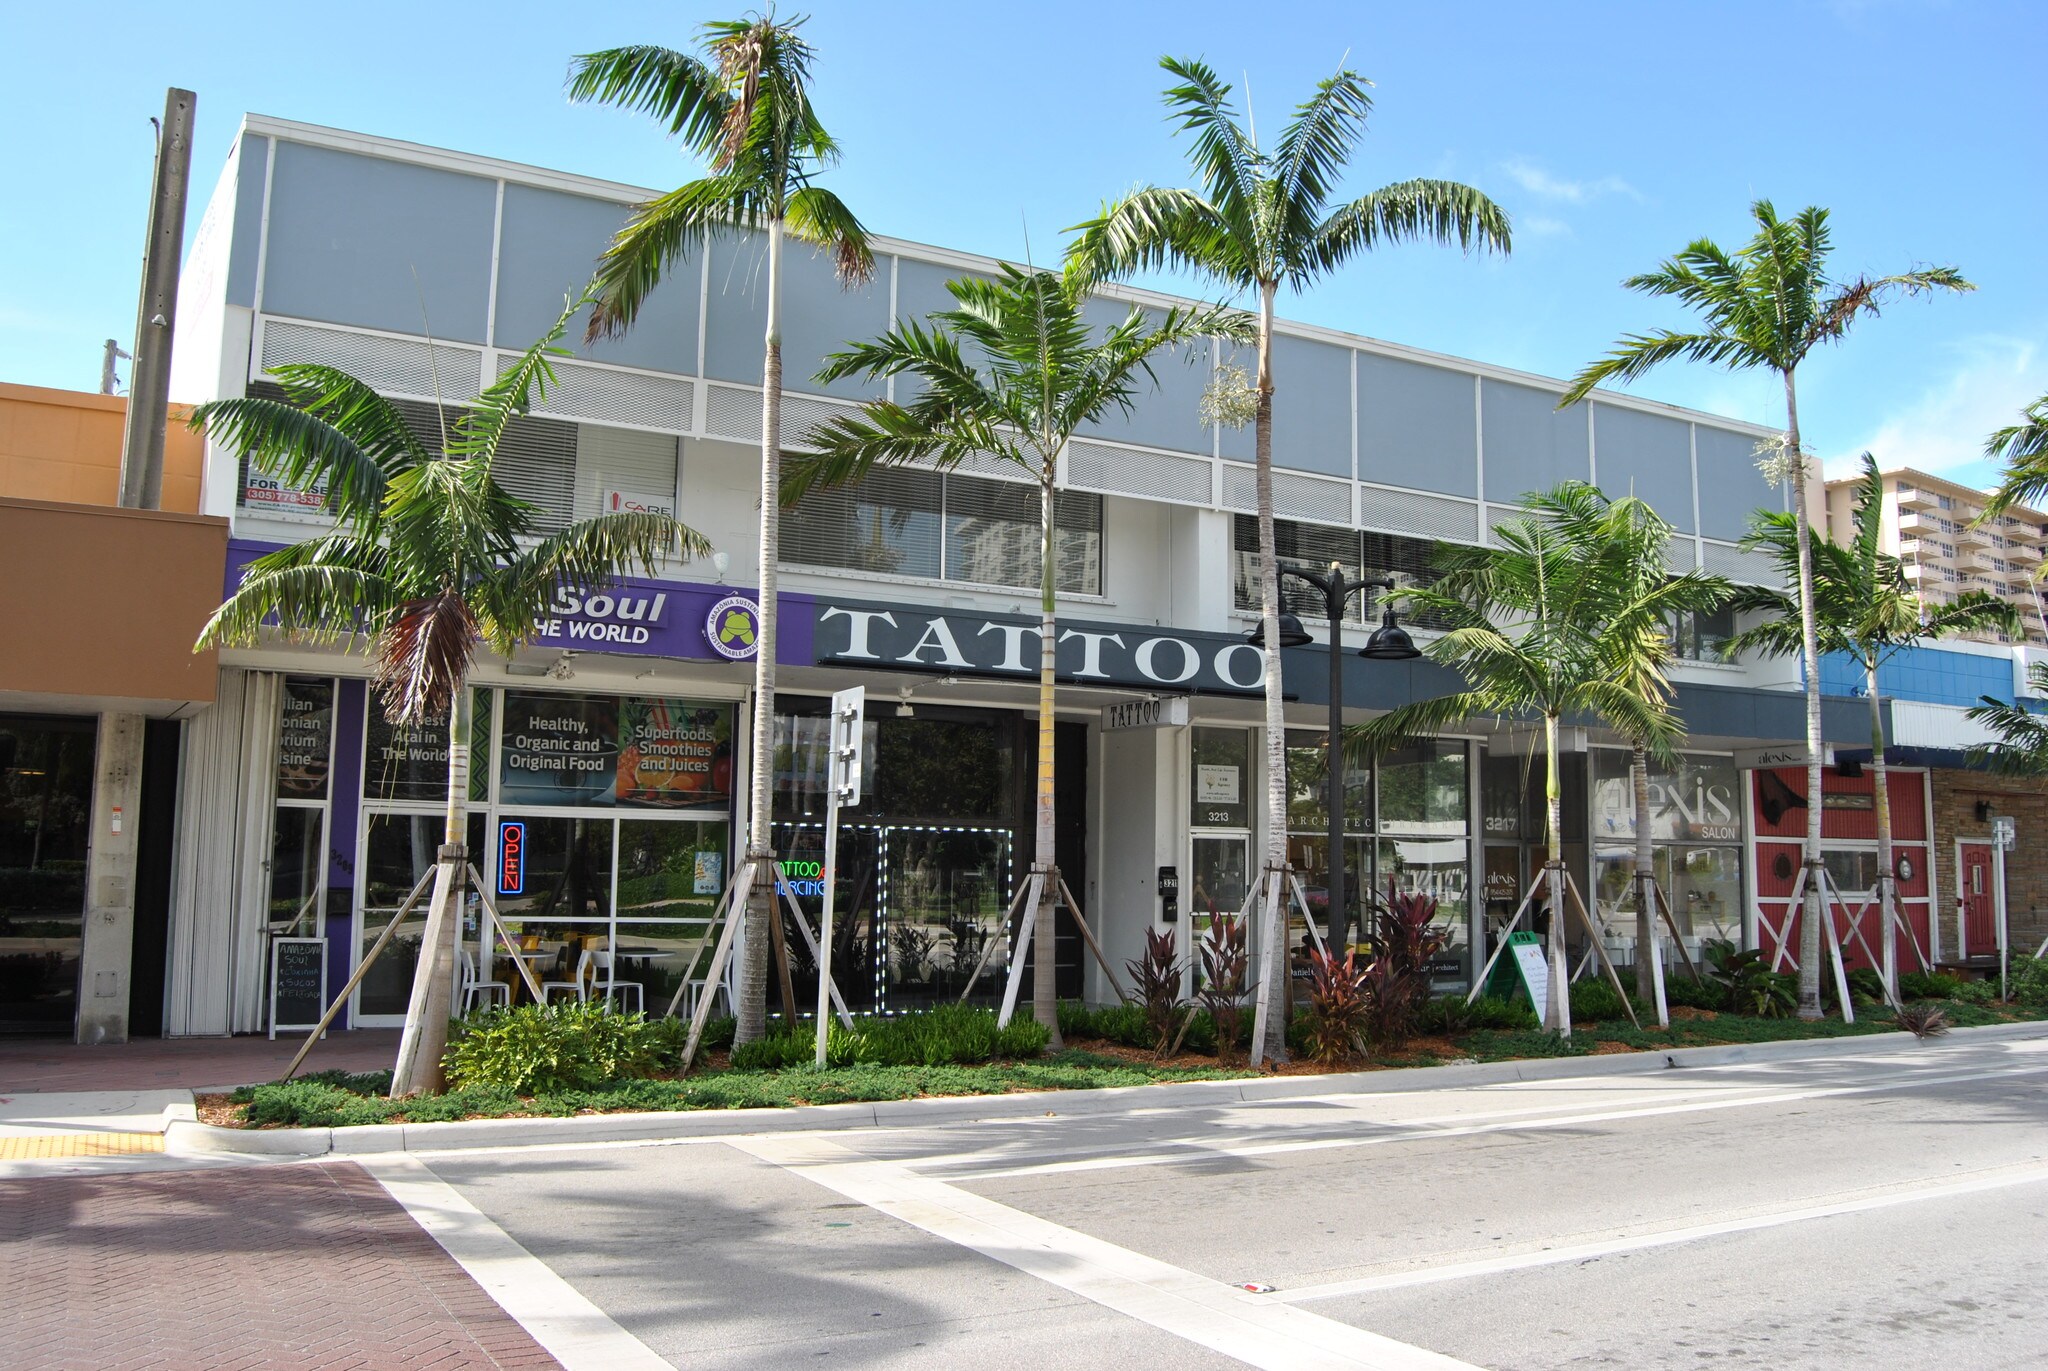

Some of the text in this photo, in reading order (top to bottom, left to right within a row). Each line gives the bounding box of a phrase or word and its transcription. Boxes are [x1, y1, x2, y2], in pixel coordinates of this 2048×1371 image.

[249, 479, 328, 494] FOR ESE
[624, 501, 671, 516] CARE
[550, 586, 666, 622] Soul
[735, 599, 760, 619] SUSTENT
[533, 618, 649, 644] HE WORLD
[820, 605, 1266, 689] TATTOO
[1110, 700, 1160, 728] TATTOO
[529, 716, 589, 734] Healthy,
[424, 731, 437, 743] in
[635, 725, 716, 743] Superfoods,
[515, 735, 600, 752] Organic and
[639, 741, 712, 757] Smoothies
[381, 747, 407, 760] The
[1758, 751, 1792, 764] alexis
[509, 754, 604, 771] Original Food
[640, 756, 710, 772] and Juices
[1208, 811, 1229, 822] 3213
[1485, 816, 1517, 831] 3217
[1701, 826, 1736, 839] SALON
[504, 826, 521, 890] OPEN
[779, 861, 821, 877] ATTOO
[1487, 870, 1516, 885] alexis
[774, 880, 826, 896] IERCING
[1291, 967, 1311, 977] aniel
[1434, 963, 1459, 972] rchitect
